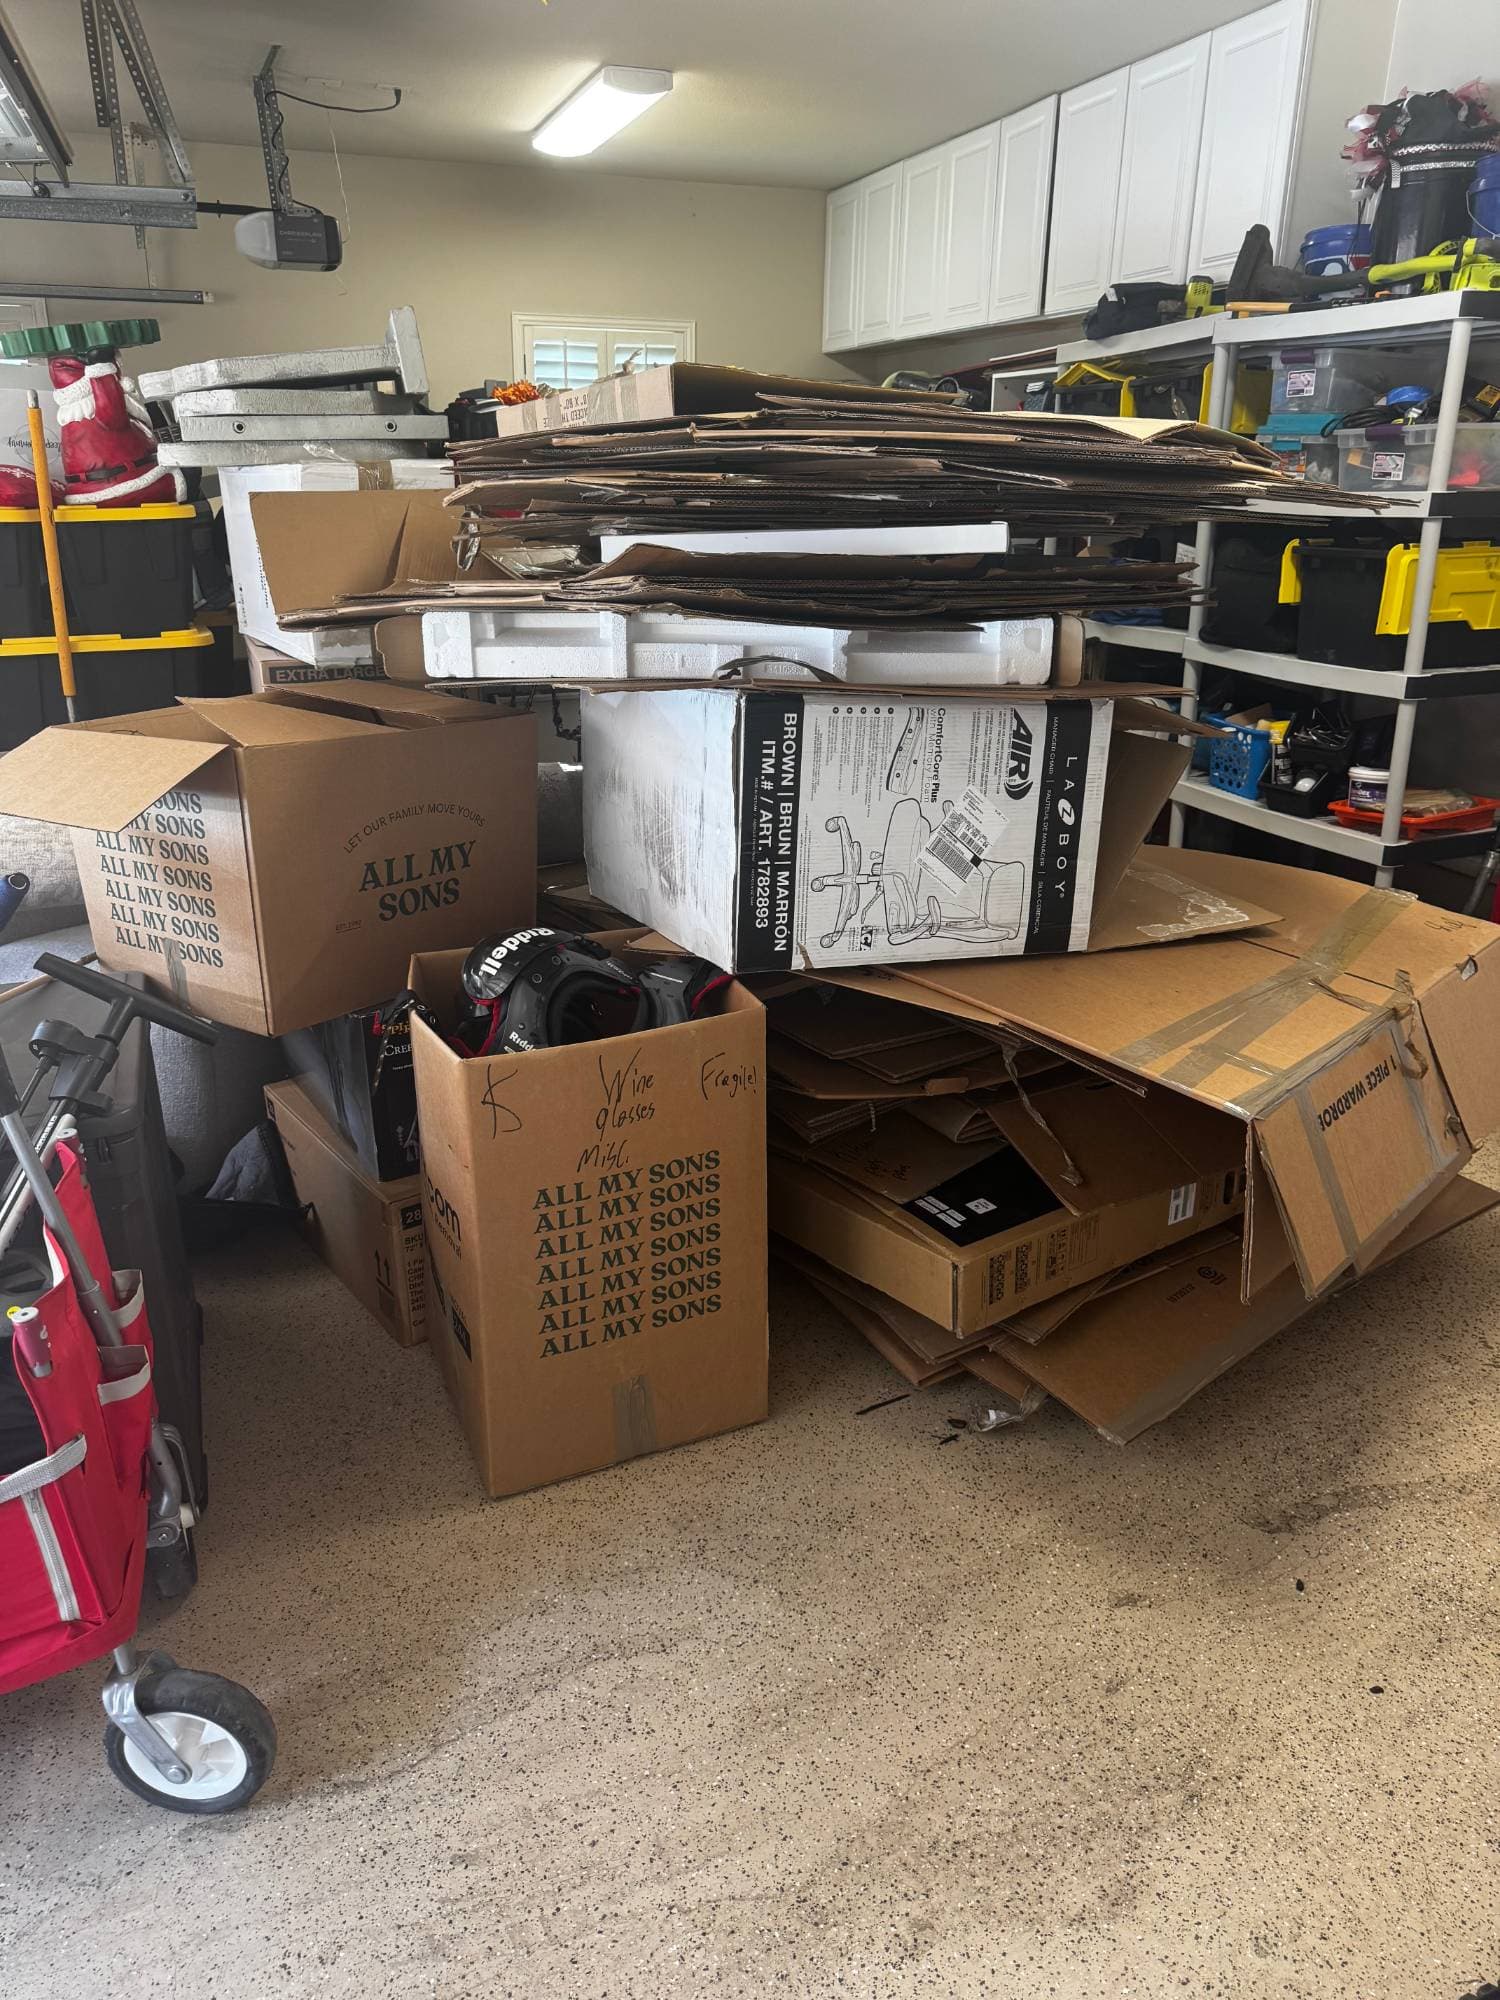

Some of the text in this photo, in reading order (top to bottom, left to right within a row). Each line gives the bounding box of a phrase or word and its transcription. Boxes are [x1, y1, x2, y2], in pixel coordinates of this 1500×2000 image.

[276, 665, 384, 682] EXTRA LARGE
[930, 708, 938, 729] with
[760, 740, 776, 791] ITM.#
[781, 713, 797, 786] BROWN
[925, 733, 936, 773] Memory
[931, 707, 946, 804] ComfortCore Plus
[1008, 708, 1033, 780] AIR
[96, 830, 209, 866] ALL MY SONS
[155, 813, 206, 839] SONS
[343, 803, 486, 854] LET OUR FAMILY MOVE YOURS
[758, 809, 773, 851] ART.
[778, 802, 792, 855] BRUN
[101, 855, 213, 892] ALL MY SONS
[358, 840, 476, 892] ALL MY
[106, 879, 216, 918] ALL MY SONS
[378, 878, 460, 922] SONS
[755, 857, 770, 929] 1782893
[774, 871, 791, 952] MARRÓN
[111, 902, 220, 943] ALL MY SONS
[116, 926, 146, 950] ALL
[148, 935, 165, 954] M
[479, 927, 556, 976] Riddell
[599, 1047, 655, 1104] Wine
[701, 1052, 758, 1101] Fragile!
[1364, 1059, 1390, 1091] PIECE
[1390, 1054, 1397, 1071] 1
[596, 1102, 656, 1141] glasses
[533, 1150, 720, 1210] ALL MY SONS
[534, 1173, 720, 1234] ALL MY SONS
[406, 1209, 422, 1223] 28
[535, 1198, 721, 1259] ALL MY SONS
[536, 1222, 721, 1285] ALL MY SONS
[537, 1247, 721, 1310] ALL MY SONS
[538, 1271, 721, 1335] ALL MY SONS
[540, 1294, 722, 1359] ALL MY SONS
